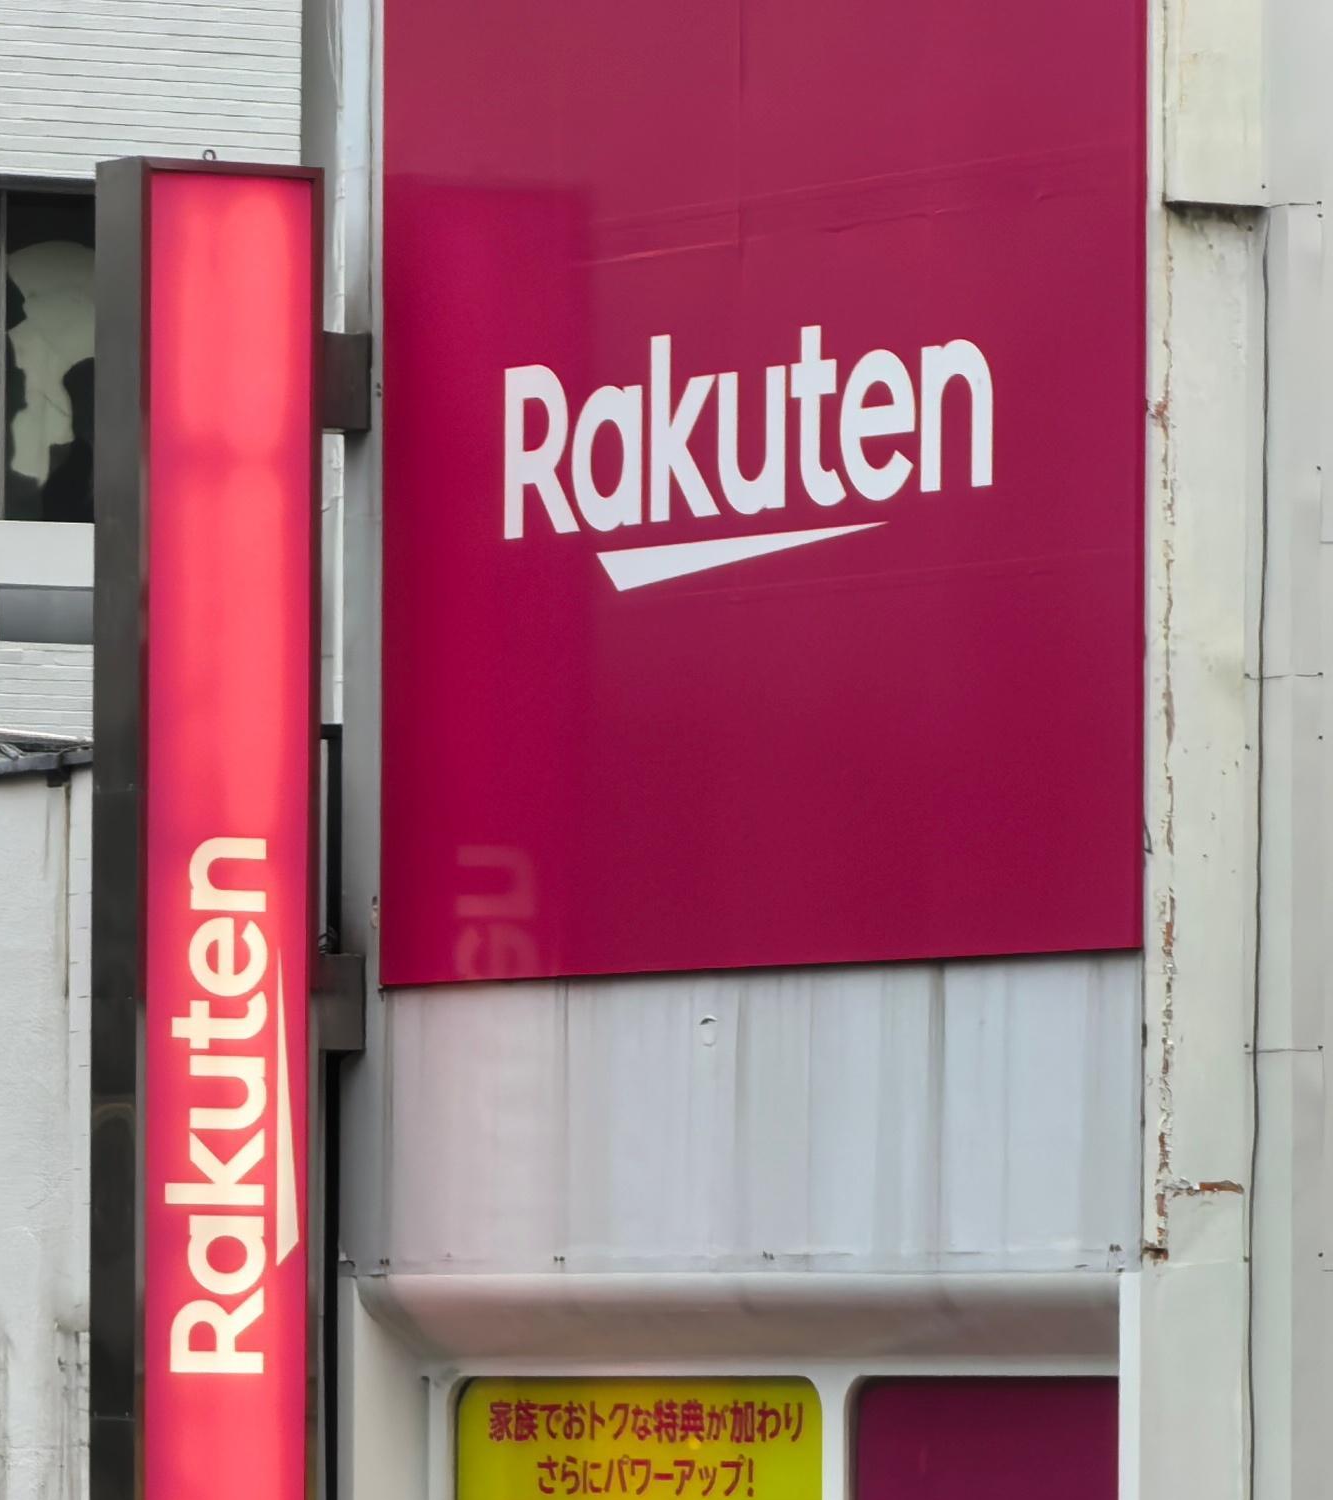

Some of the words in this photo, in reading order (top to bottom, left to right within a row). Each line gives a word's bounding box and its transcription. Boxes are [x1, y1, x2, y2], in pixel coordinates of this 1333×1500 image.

[503, 325, 993, 540] Rakuten
[164, 836, 268, 1375] Rakuten
[489, 1398, 804, 1443] 家族でおトクな特典が加わり
